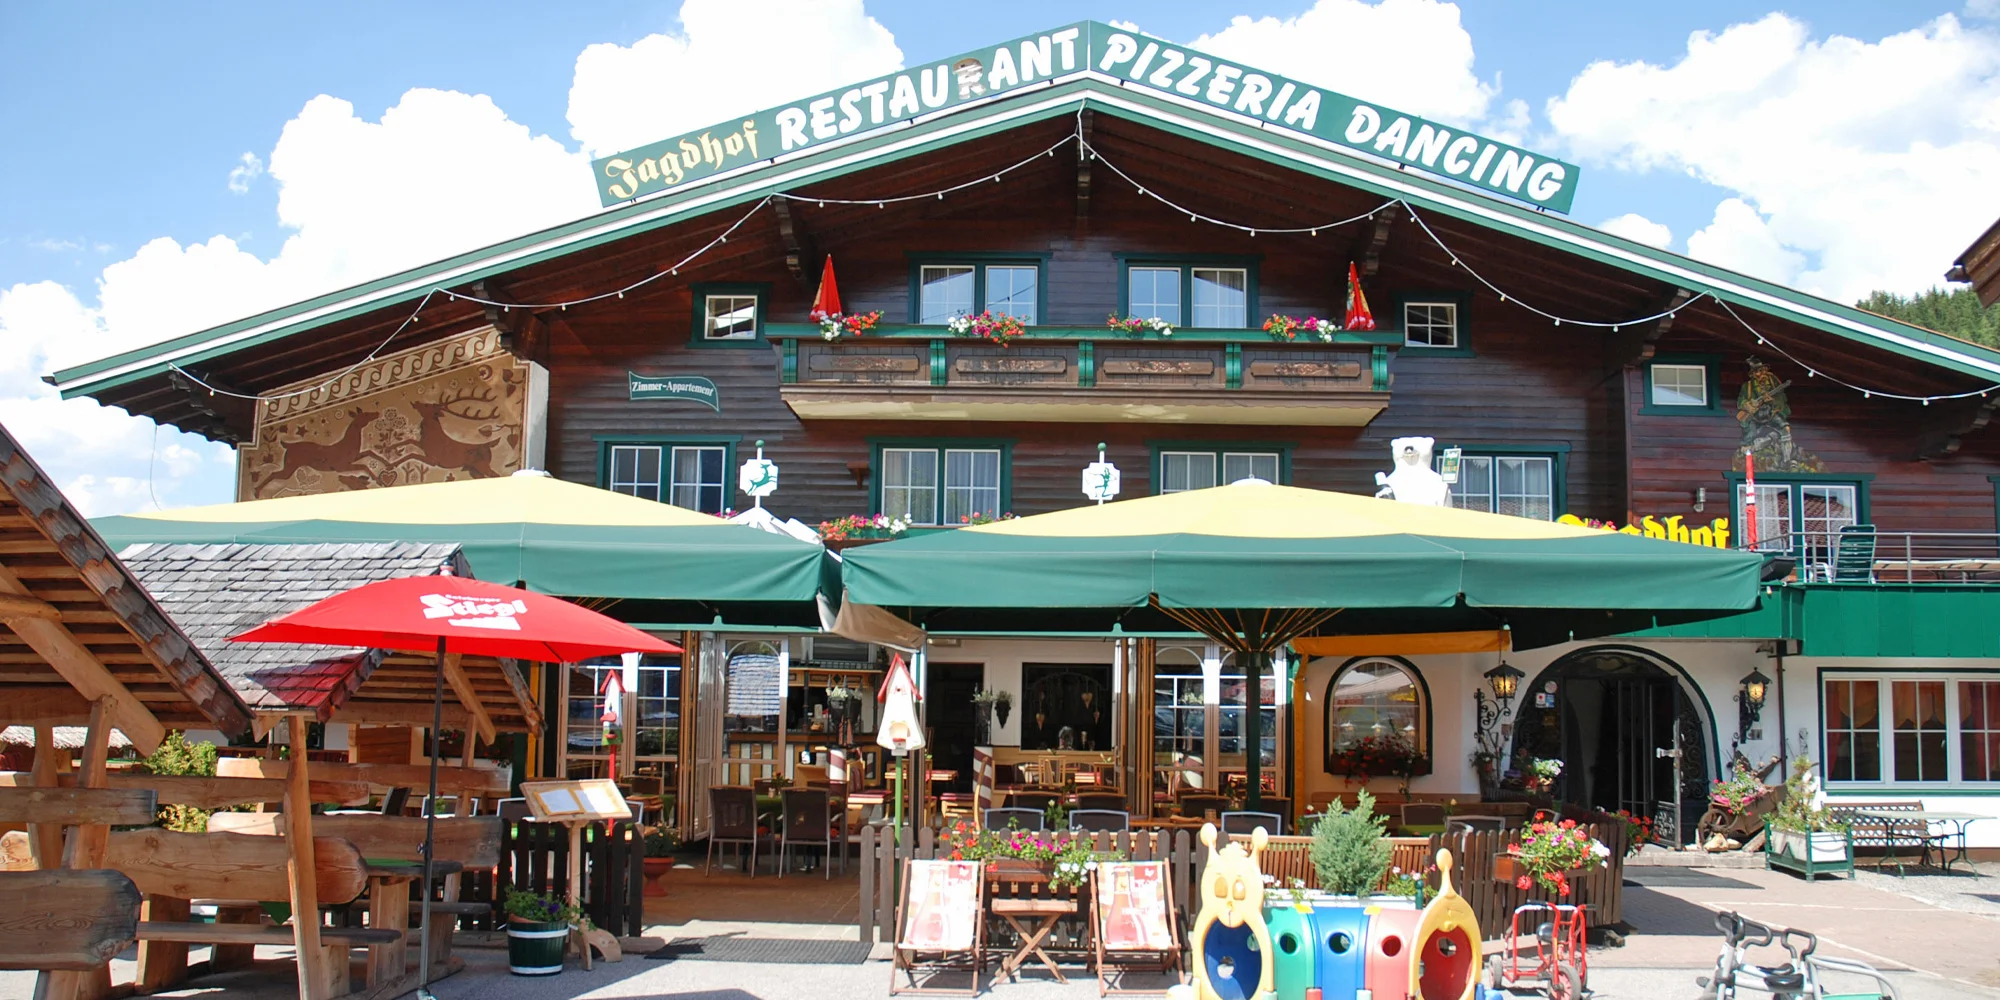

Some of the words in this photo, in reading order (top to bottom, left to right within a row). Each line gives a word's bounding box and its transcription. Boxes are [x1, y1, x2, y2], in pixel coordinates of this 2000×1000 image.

[605, 119, 758, 199] Jagdhof
[775, 27, 1079, 151] RESTAURANT
[1099, 33, 1321, 131] PIZZERIA
[1344, 104, 1566, 201] DANCING
[631, 380, 714, 397] Zimmer-Appartement
[1557, 514, 1730, 549] dhof
